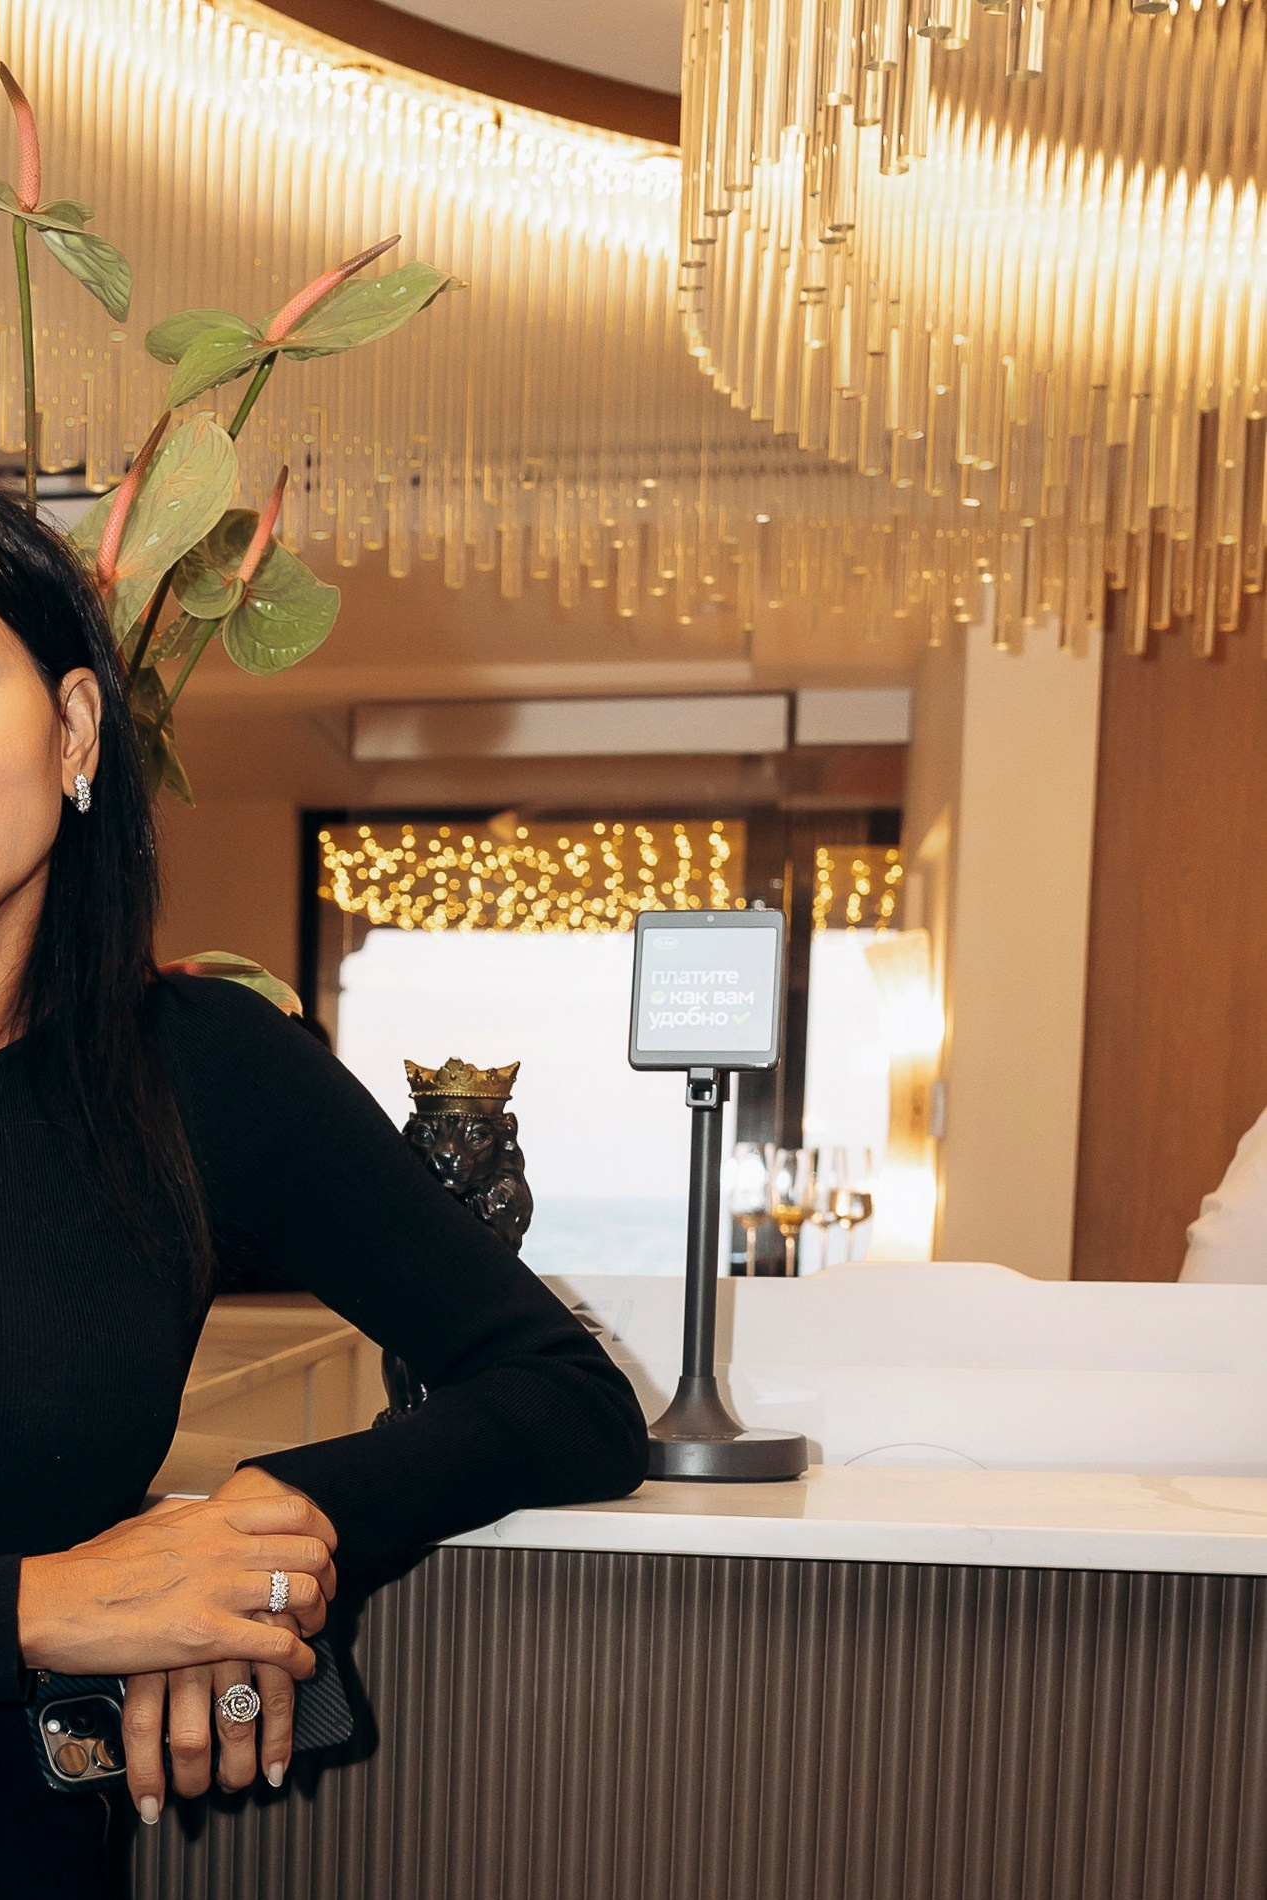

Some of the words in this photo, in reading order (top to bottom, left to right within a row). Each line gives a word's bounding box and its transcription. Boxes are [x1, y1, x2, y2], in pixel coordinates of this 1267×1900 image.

[651, 970, 739, 985] платите
[669, 991, 709, 1005] как
[713, 991, 755, 1005] вам
[649, 1006, 729, 1030] удобно
